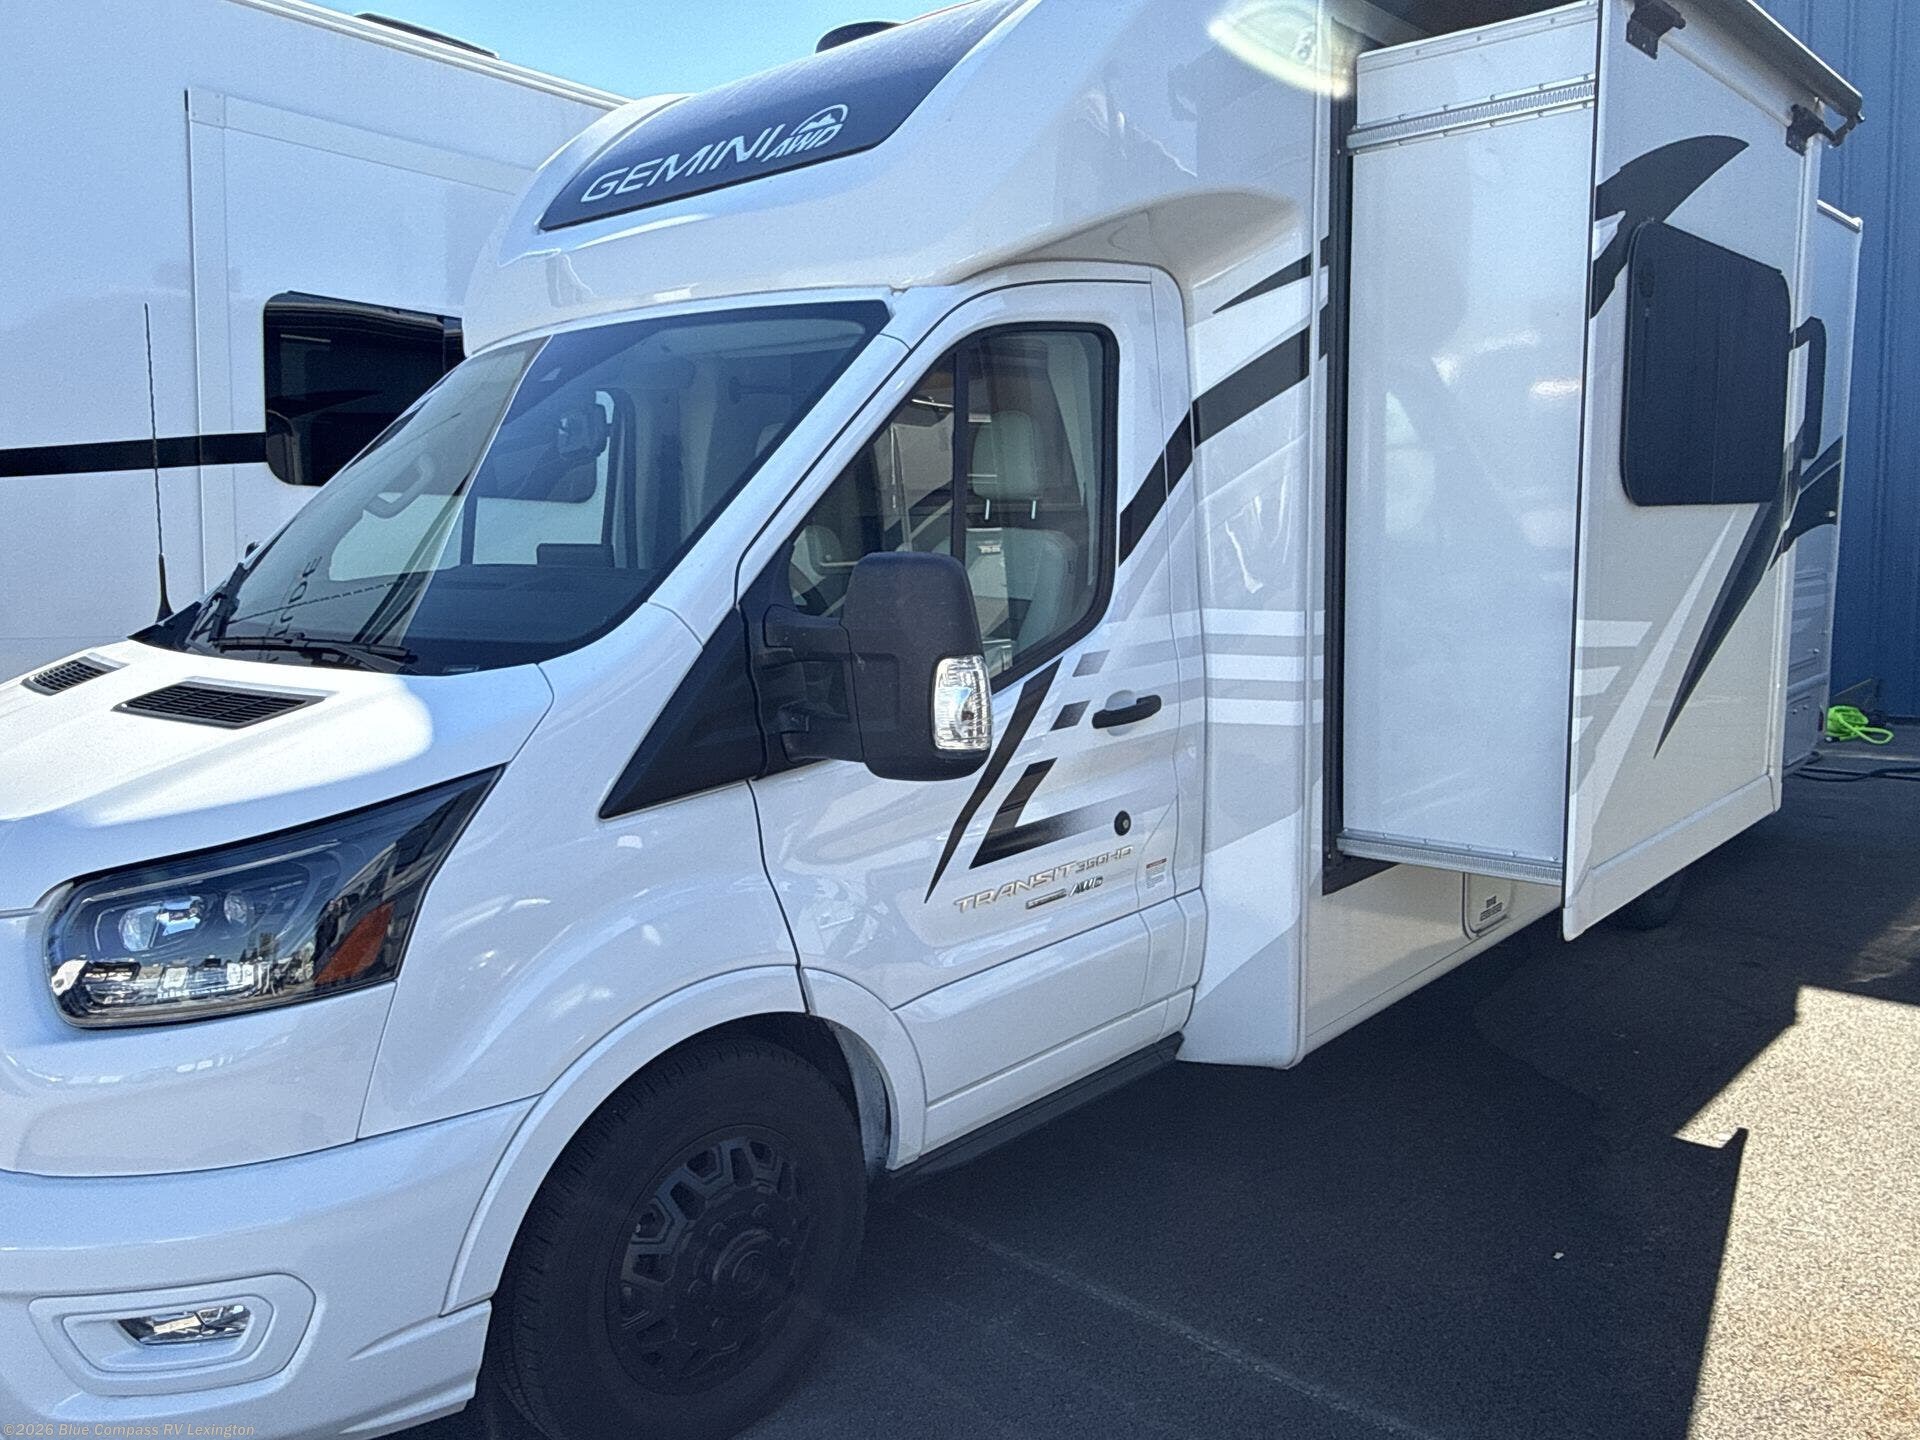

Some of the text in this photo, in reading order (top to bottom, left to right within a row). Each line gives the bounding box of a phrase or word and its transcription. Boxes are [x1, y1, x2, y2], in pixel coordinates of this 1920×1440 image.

[580, 123, 843, 203] GEMINI AWD
[953, 860, 1077, 914] TRANSIT
[1069, 875, 1104, 897] AWD
